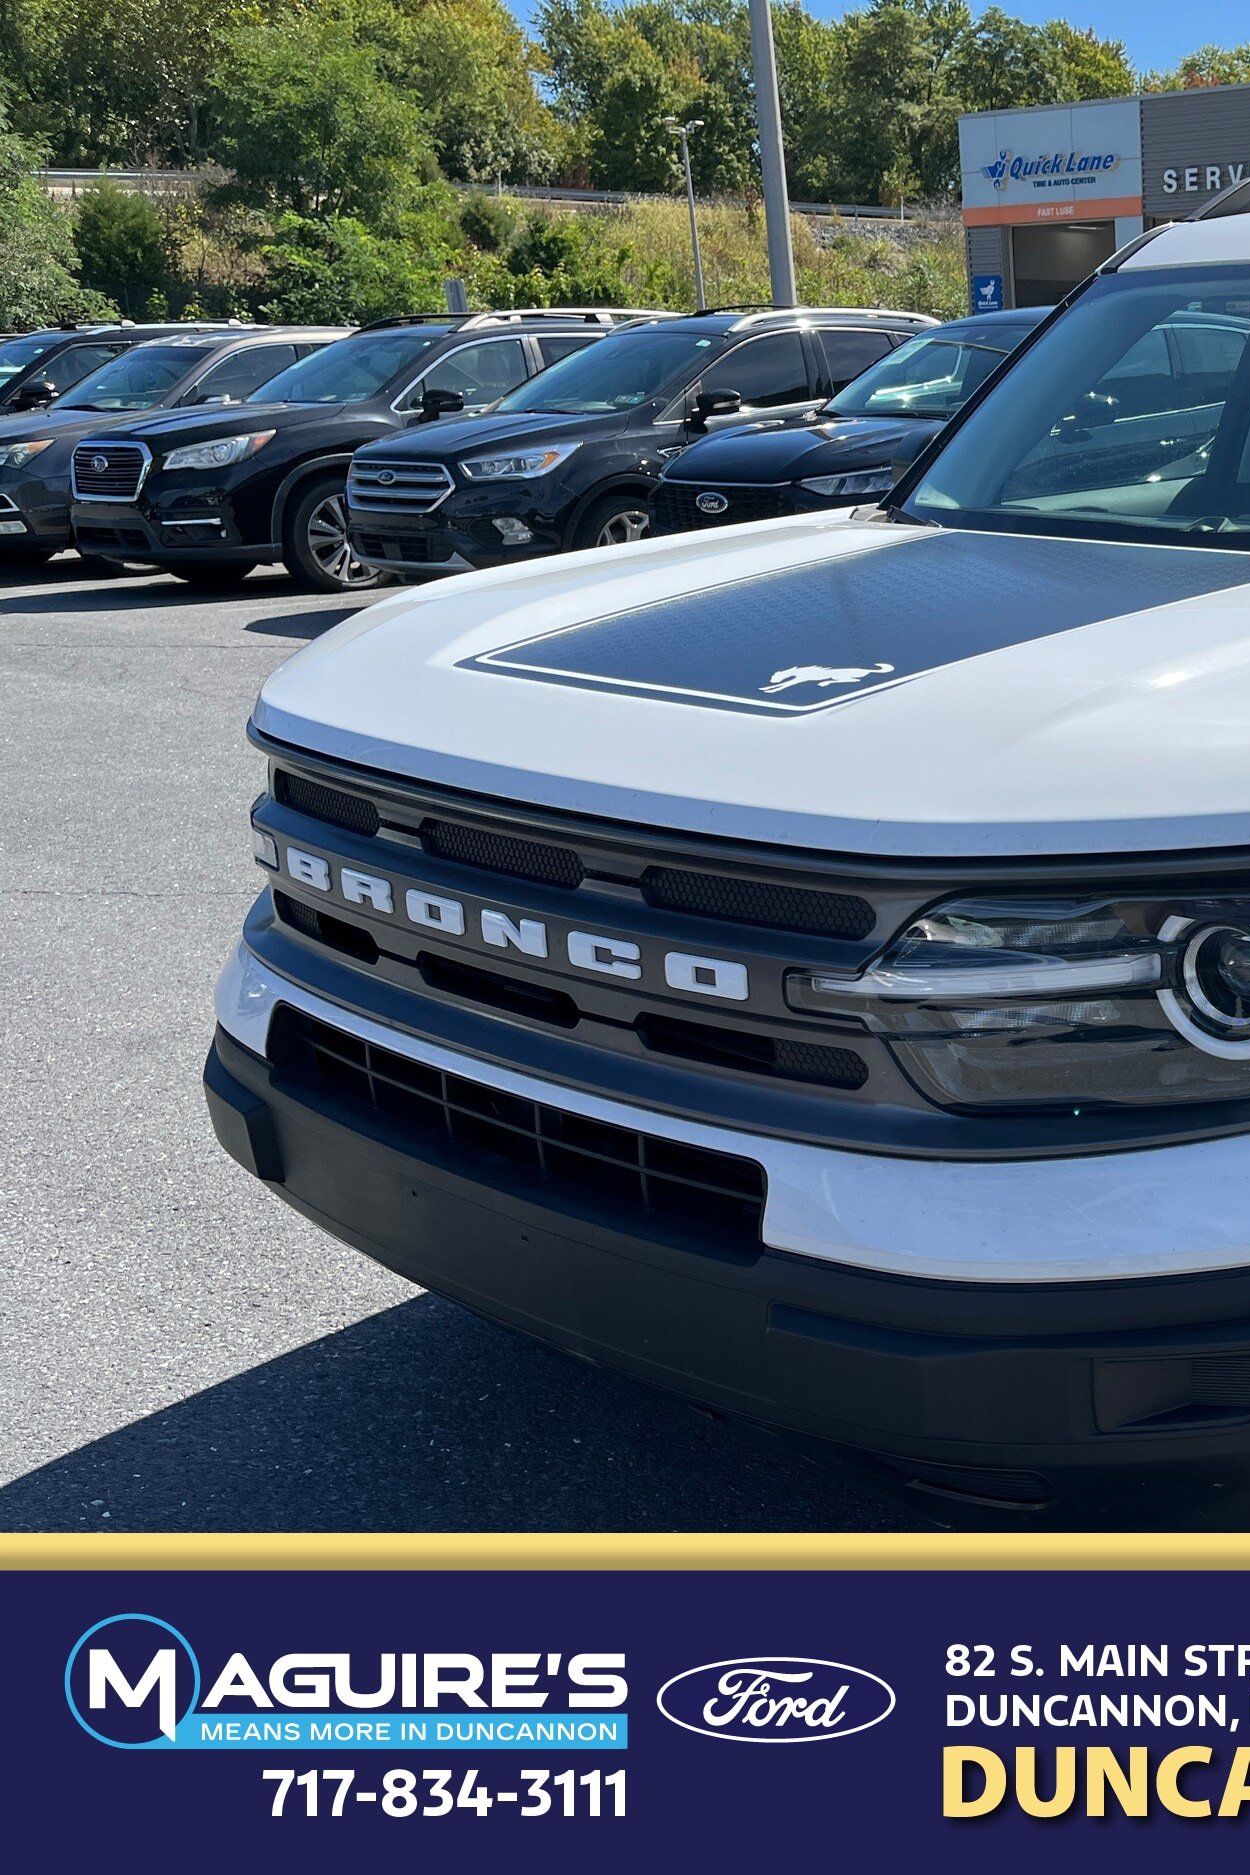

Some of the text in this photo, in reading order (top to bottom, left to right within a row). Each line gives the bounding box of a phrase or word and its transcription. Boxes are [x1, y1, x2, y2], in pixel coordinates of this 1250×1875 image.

[1010, 152, 1115, 179] Quick Lane
[1033, 180, 1047, 188] TIRE
[1053, 178, 1070, 187] AUTO
[1071, 176, 1097, 186] CENTER
[1037, 206, 1075, 217] FAST LUBE
[286, 846, 750, 1001] BRONCO
